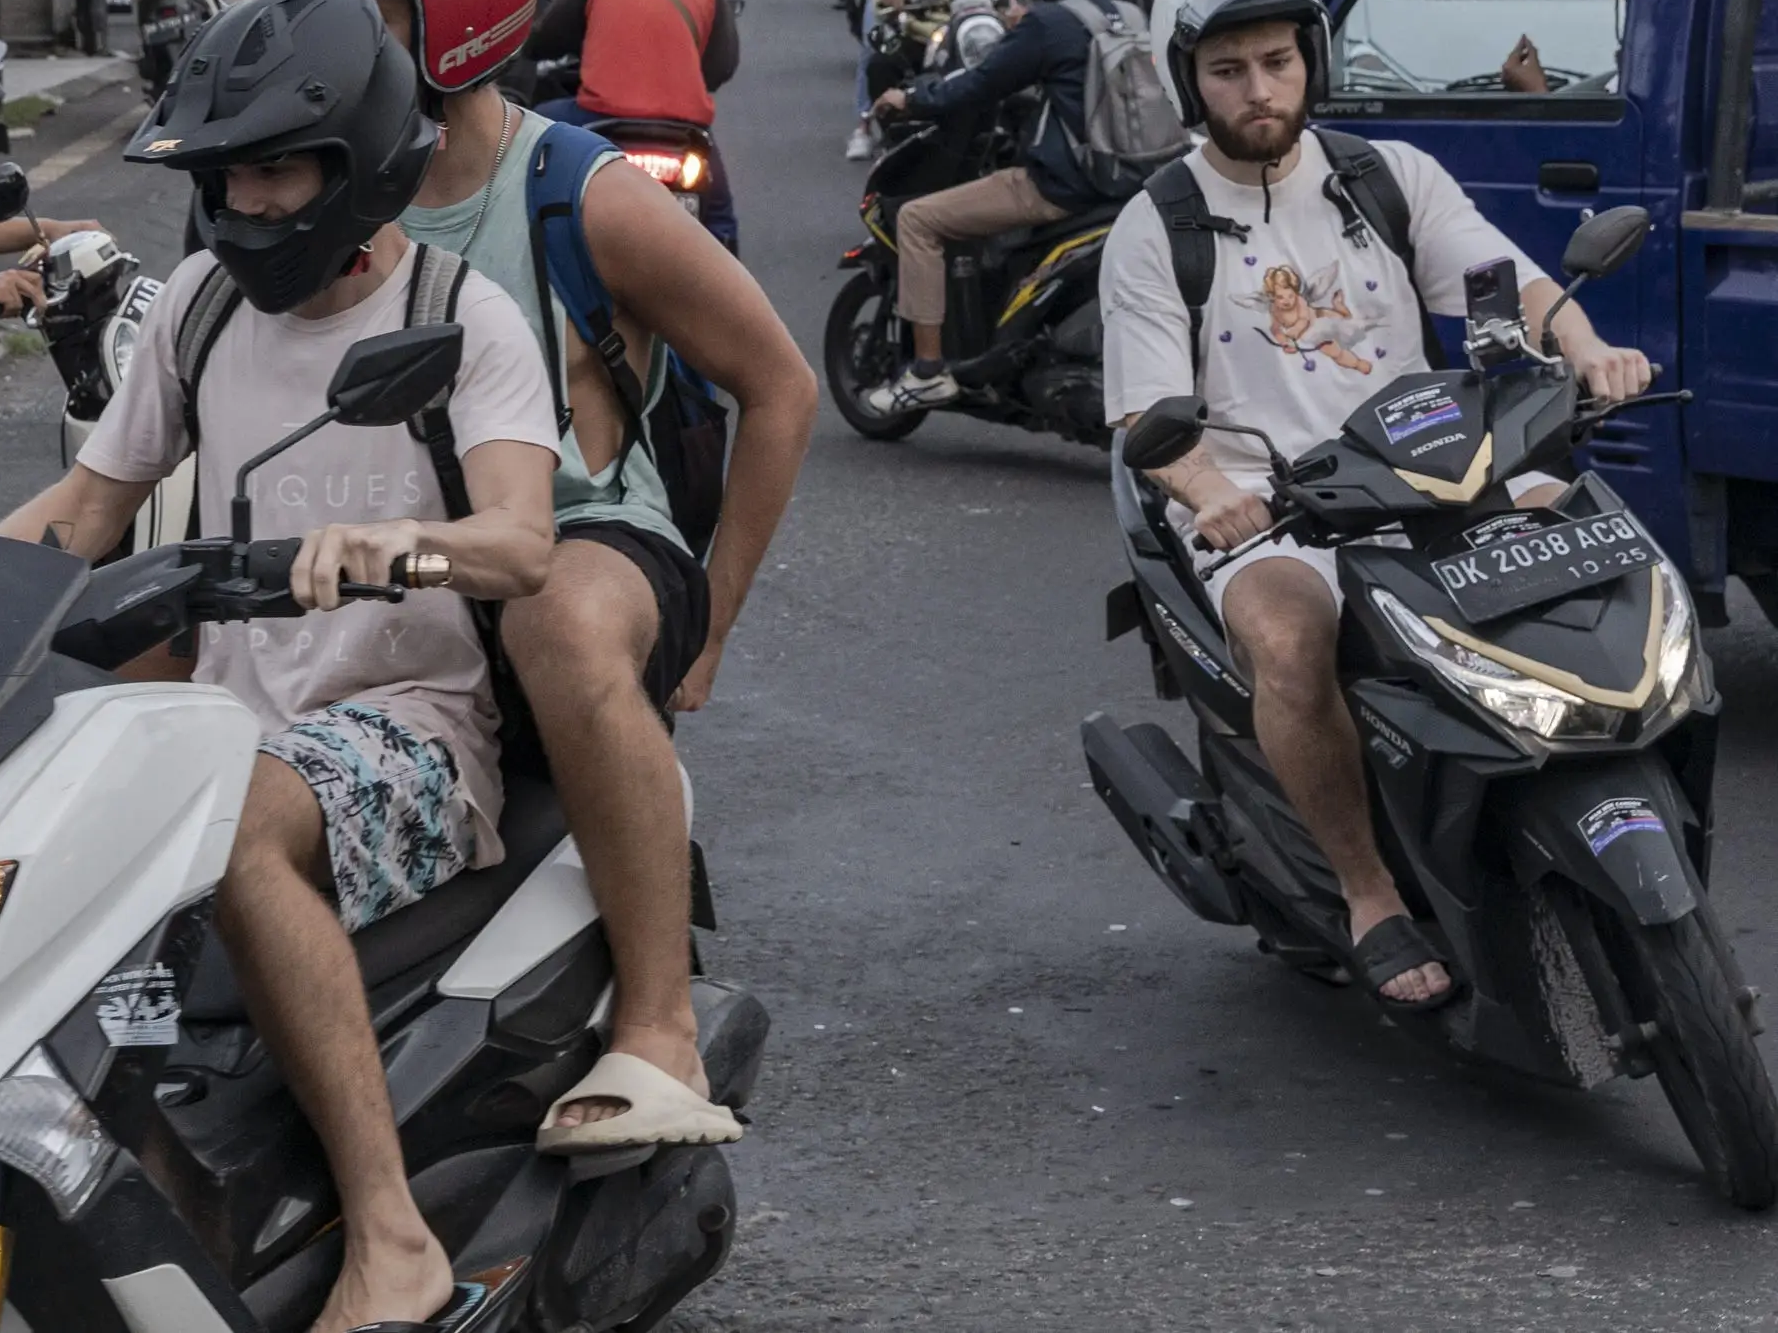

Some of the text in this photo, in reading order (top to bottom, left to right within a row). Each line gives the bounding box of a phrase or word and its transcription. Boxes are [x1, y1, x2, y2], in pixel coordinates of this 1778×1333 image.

[1410, 432, 1467, 457] HONDA
[1441, 557, 1489, 589] DK
[1491, 533, 1570, 574] 2038
[1360, 705, 1414, 758] HONDA
